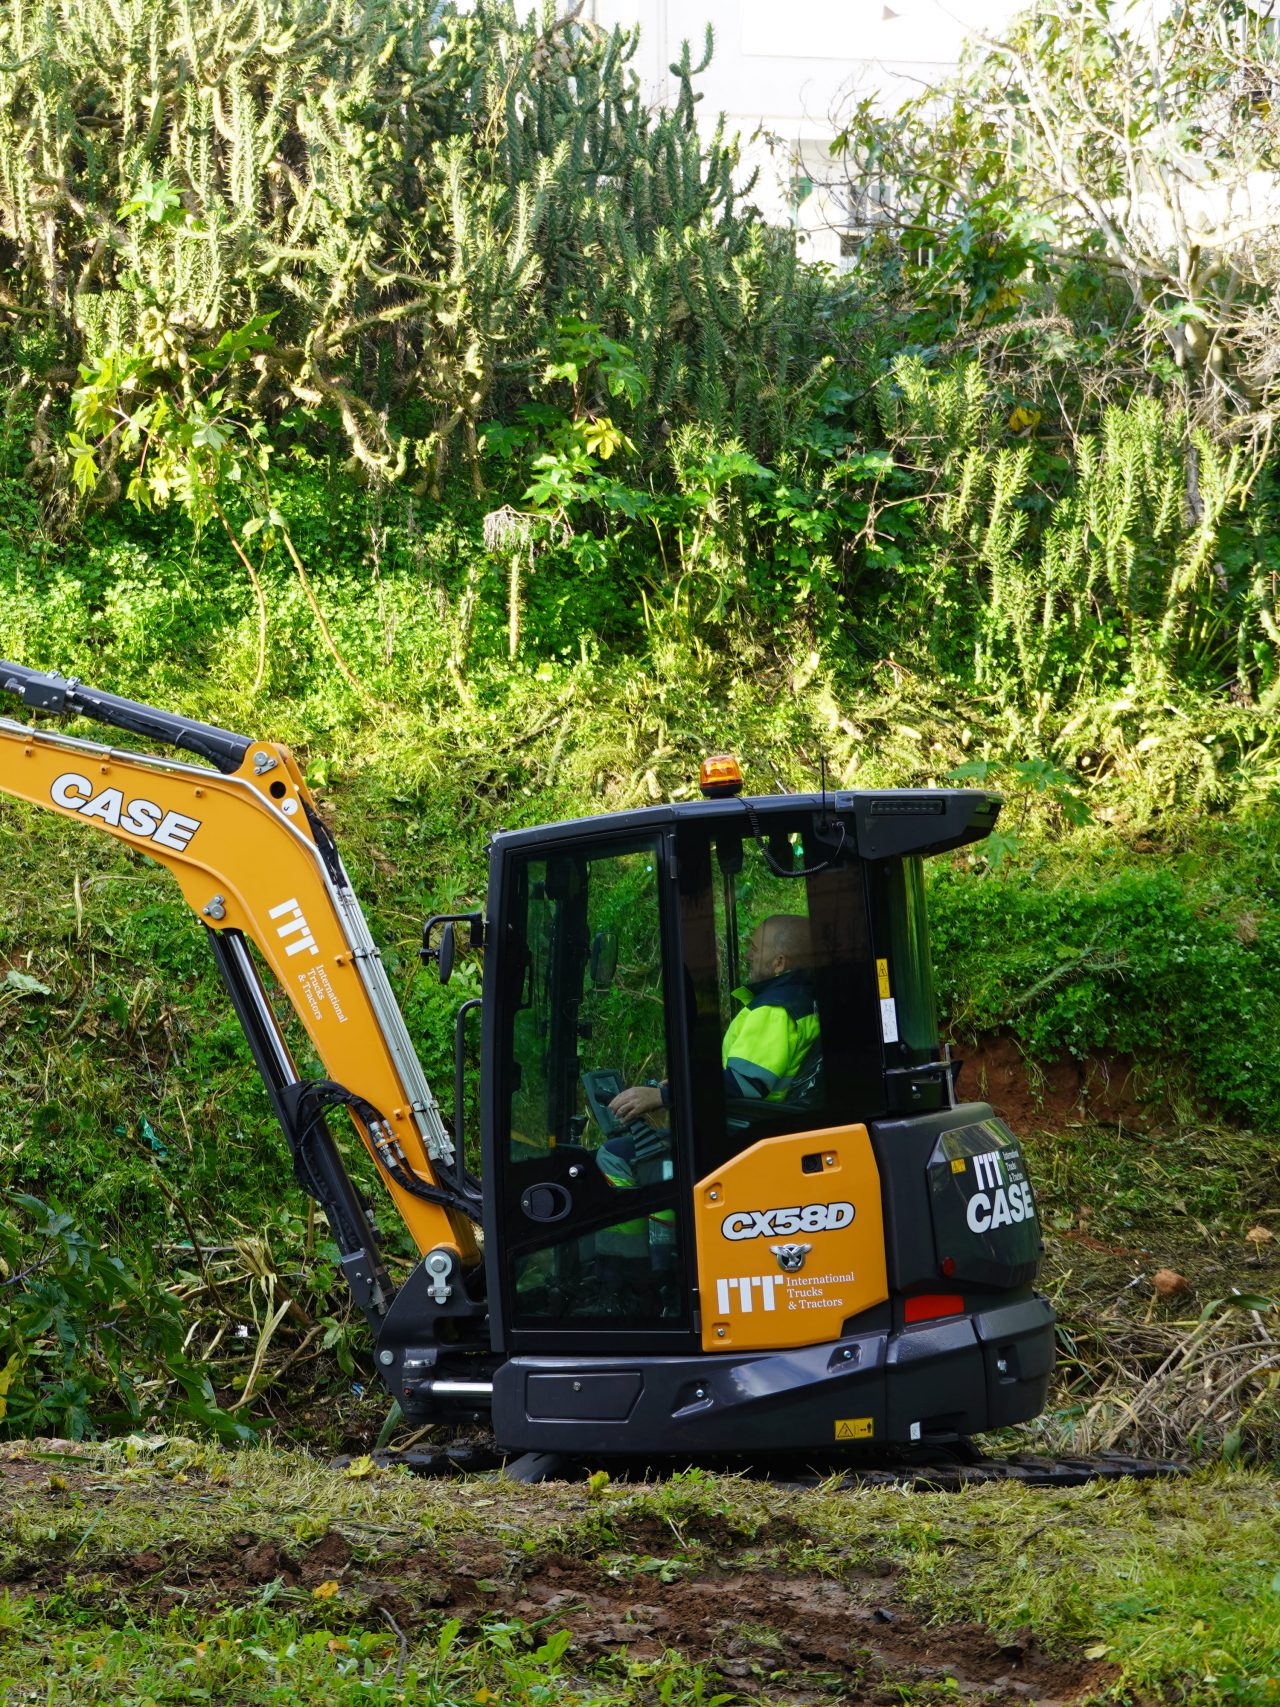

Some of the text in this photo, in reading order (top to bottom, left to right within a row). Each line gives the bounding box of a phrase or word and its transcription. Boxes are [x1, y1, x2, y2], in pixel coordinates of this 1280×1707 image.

[50, 772, 202, 852] CASE
[298, 974, 323, 1021] & Tractors
[307, 968, 325, 1000] Trucks
[316, 964, 348, 1023] International
[721, 1201, 856, 1241] CX58D
[966, 1181, 1035, 1233] CASE
[786, 1272, 855, 1287] International
[786, 1287, 823, 1298] Trucks
[788, 1298, 844, 1310] & Tractors
